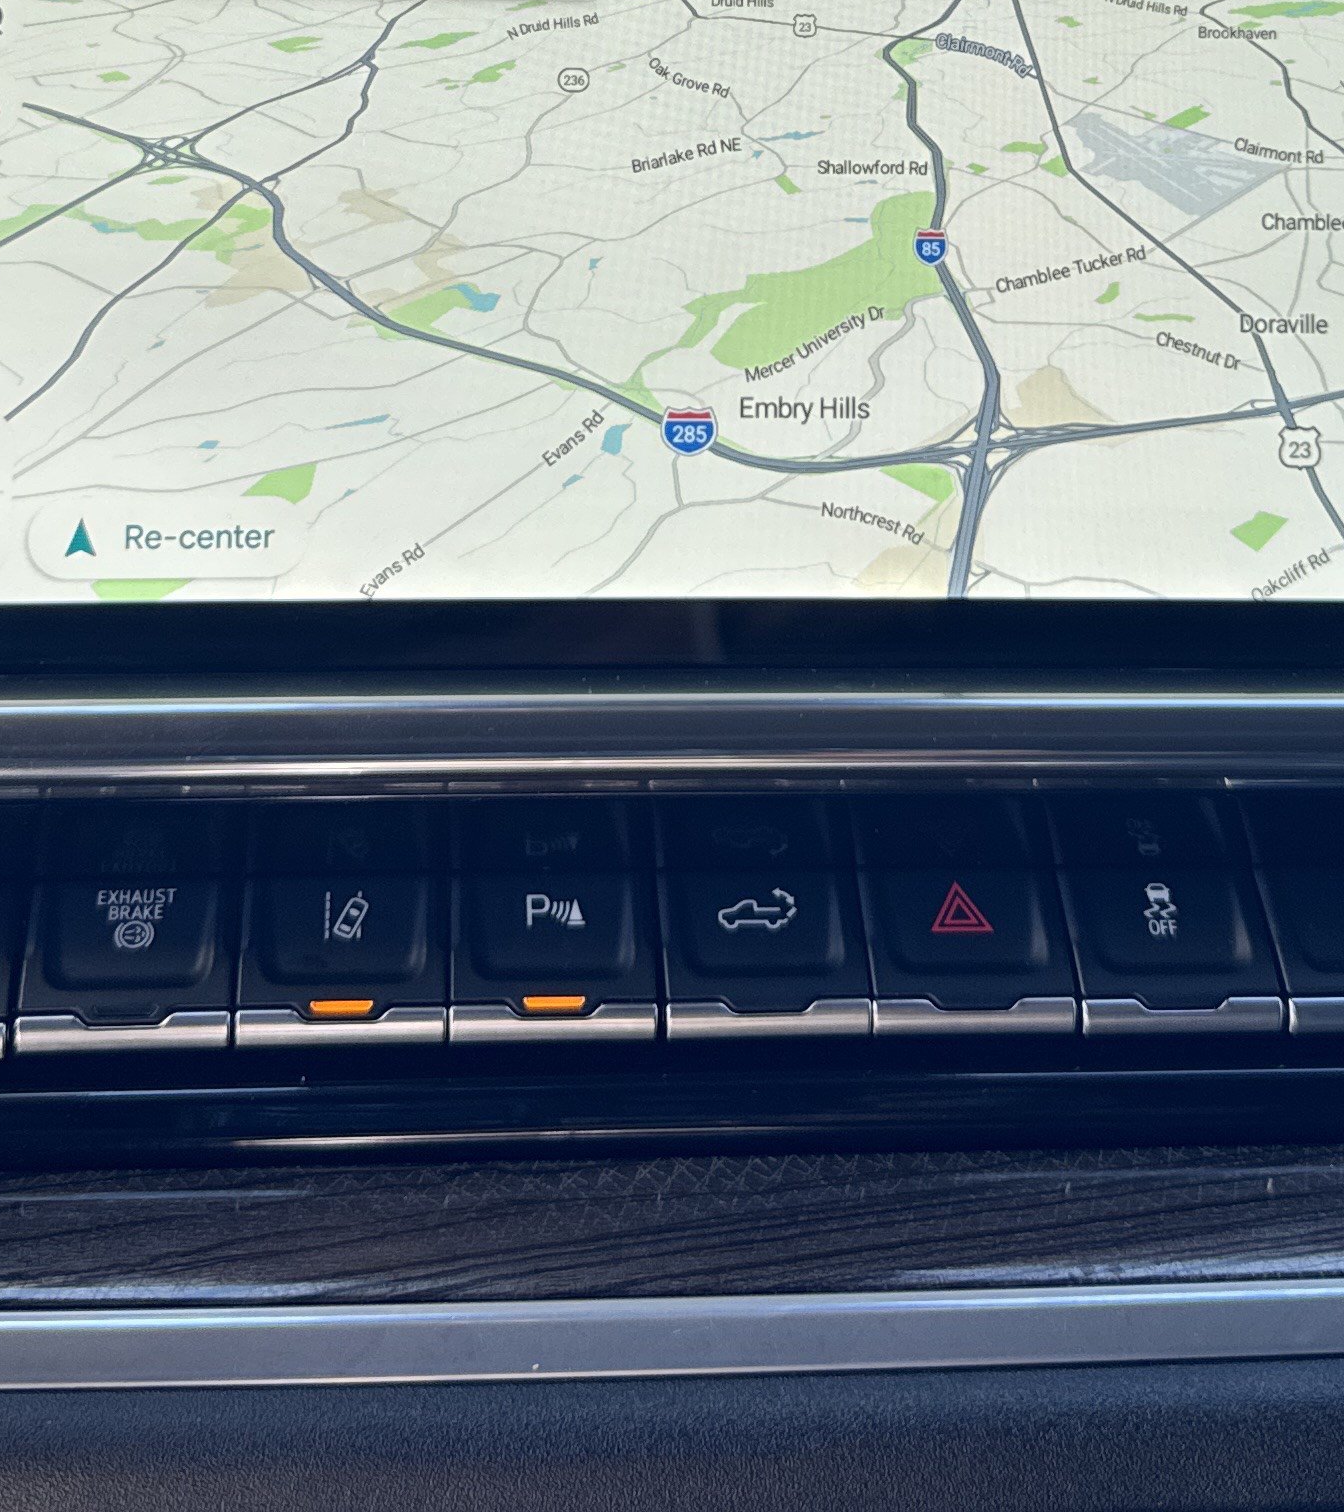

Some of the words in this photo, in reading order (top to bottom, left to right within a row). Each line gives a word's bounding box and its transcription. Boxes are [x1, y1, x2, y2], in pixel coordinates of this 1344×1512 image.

[1146, 0, 1171, 15] Hills
[1173, 5, 1188, 16] Rd
[506, 28, 518, 41] N
[519, 17, 551, 36] Druid
[553, 15, 581, 31] Hills
[583, 13, 600, 25] Rd
[799, 23, 811, 32] 23
[1198, 26, 1277, 40] Brookhaven
[936, 32, 1012, 66] Clairmont
[1010, 54, 1033, 78] Rd
[563, 75, 585, 86] 236
[649, 58, 670, 80] Oak
[672, 72, 710, 94] Grove
[712, 84, 731, 99] Rd
[631, 147, 694, 173] Briarlake
[696, 142, 717, 157] Rd
[720, 138, 742, 153] NE
[1234, 138, 1303, 163] Clairmont
[1305, 150, 1324, 164] Rd
[817, 160, 905, 175] Shallowford
[909, 162, 928, 176] Rd
[921, 241, 940, 257] 85
[995, 264, 1071, 293] Chamblee
[1072, 253, 1123, 275] Tucker
[1125, 245, 1147, 263] Rd
[1239, 313, 1329, 335] Doraville
[744, 354, 797, 383] Mercer
[795, 315, 866, 360] University
[866, 306, 884, 321] Dr
[1156, 331, 1223, 365] Chestnut
[1223, 354, 1241, 371] Dr
[740, 397, 814, 425] Embry
[820, 397, 871, 420] Hills
[541, 426, 588, 467] Evans
[580, 408, 605, 434] Rd
[672, 425, 707, 443] 285
[1288, 442, 1312, 459] 23
[124, 523, 276, 550] Re-center
[820, 502, 902, 536] Northcrest
[901, 523, 924, 546] Rd
[360, 561, 403, 598] Evans
[402, 542, 425, 565] Rd
[1251, 560, 1307, 601] Oakcliff
[1307, 547, 1330, 570] Rd
[97, 888, 177, 905] EXHAUST
[108, 904, 164, 920] BRAKE
[526, 894, 550, 928] P
[1148, 919, 1177, 936] OFF
